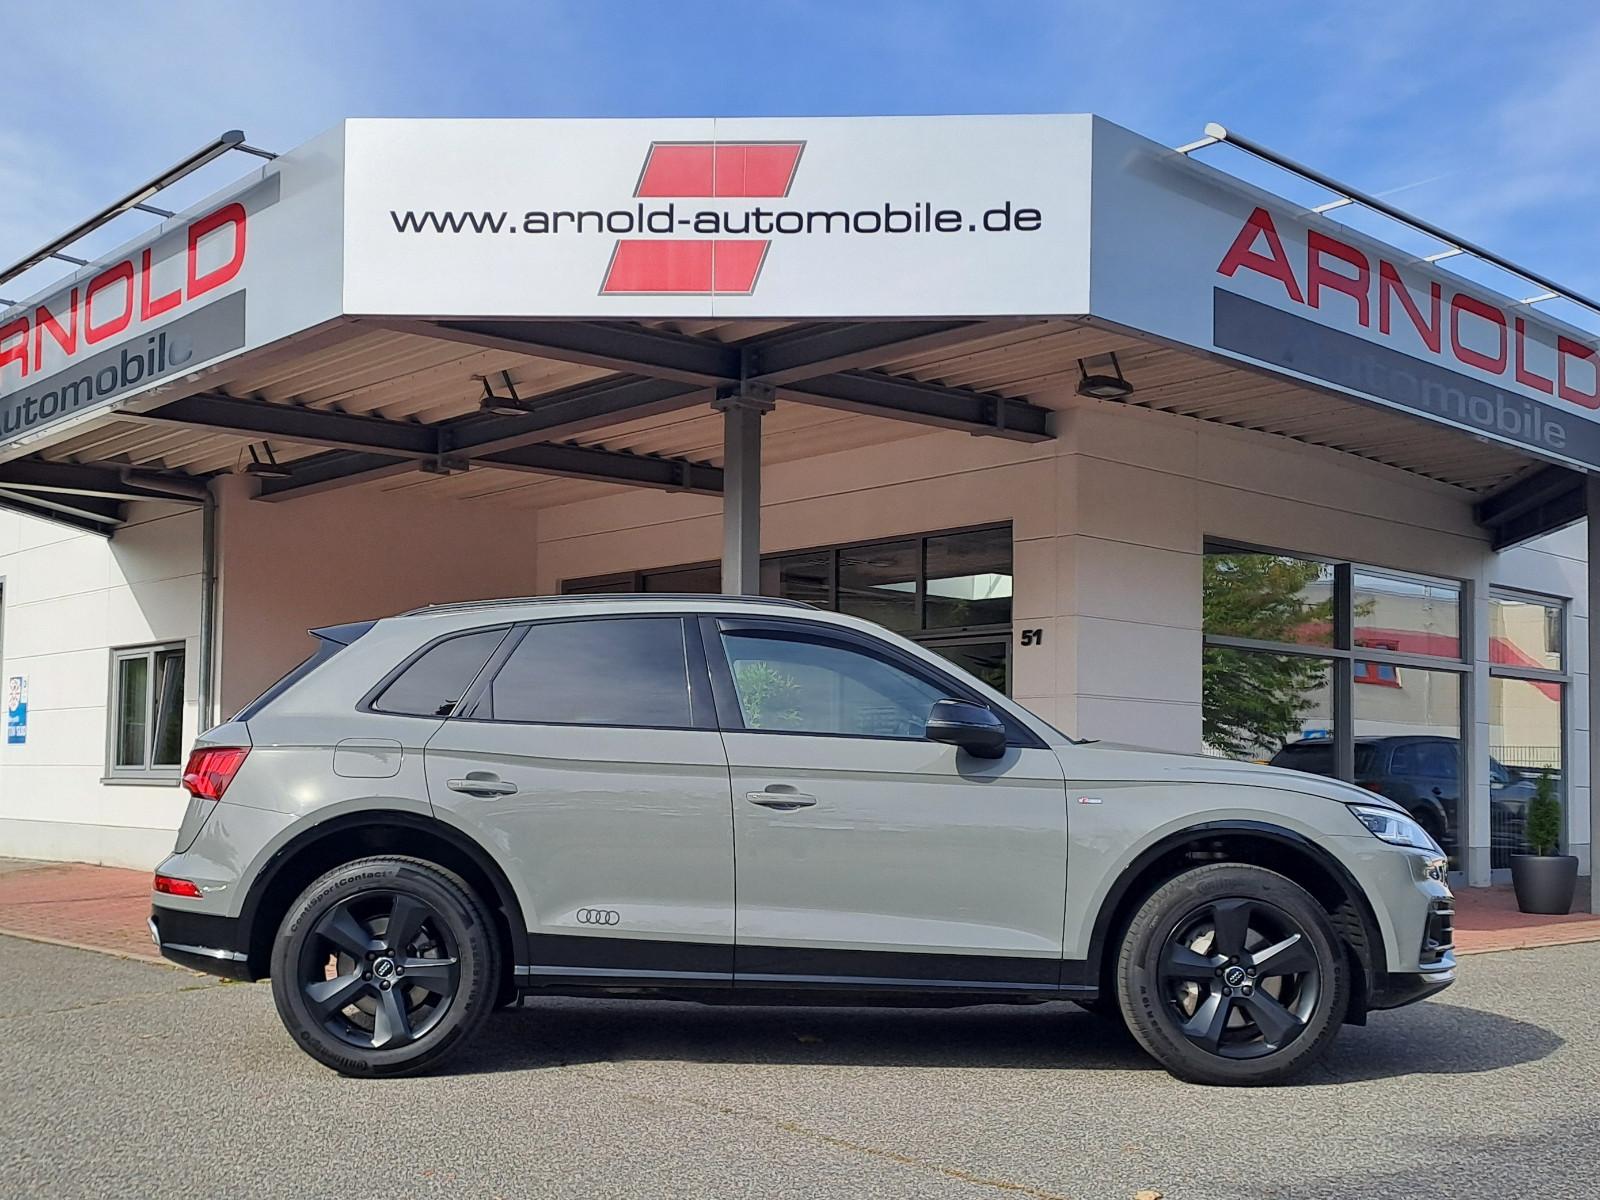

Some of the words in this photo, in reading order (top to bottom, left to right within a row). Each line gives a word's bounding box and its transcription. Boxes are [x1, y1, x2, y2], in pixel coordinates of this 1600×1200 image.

[389, 201, 1042, 234] www.arnold-automobile.de
[1216, 206, 1600, 410] ARNOLD
[1021, 629, 1043, 646] 51
